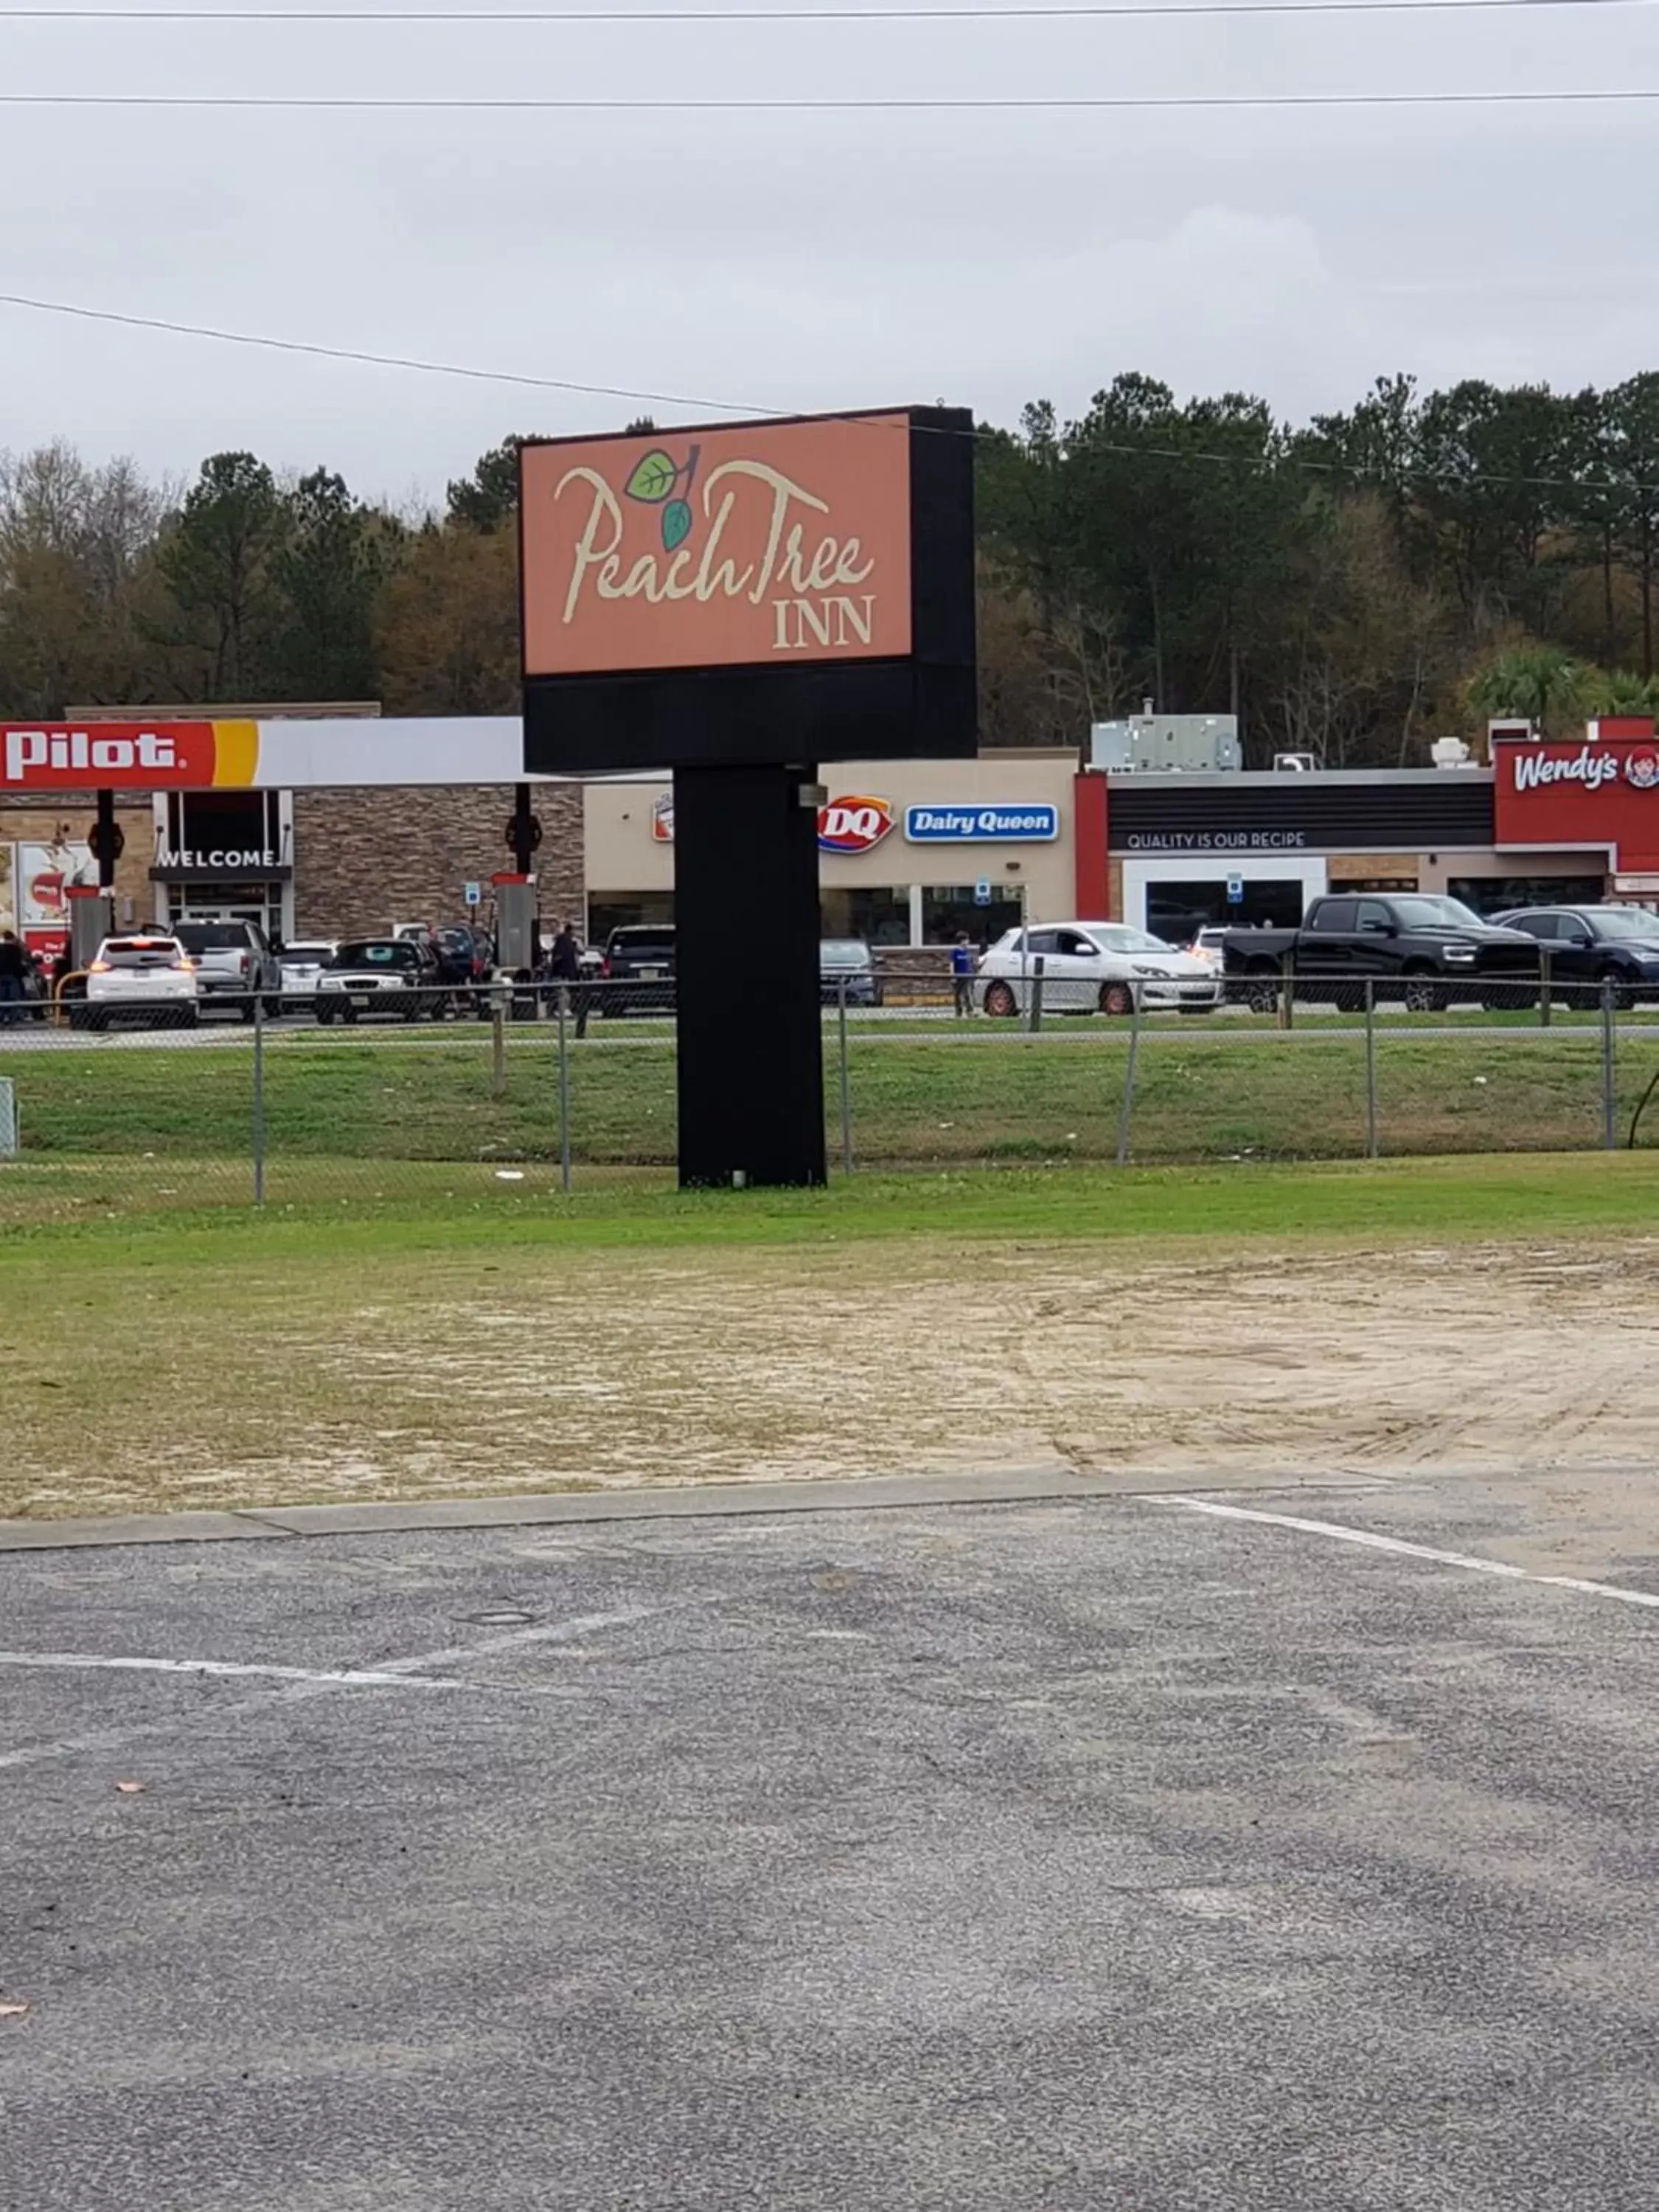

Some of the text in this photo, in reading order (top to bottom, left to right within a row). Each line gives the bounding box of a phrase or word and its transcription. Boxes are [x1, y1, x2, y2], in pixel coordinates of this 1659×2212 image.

[554, 459, 874, 624] Peach Tree
[772, 594, 877, 650] INN
[5, 731, 175, 780] Pilot
[1514, 745, 1618, 791] Wendy's
[824, 808, 880, 839] DQ
[914, 811, 1050, 833] Dairy Queen
[1127, 831, 1306, 849] QUALITY IS OUR RECIPE
